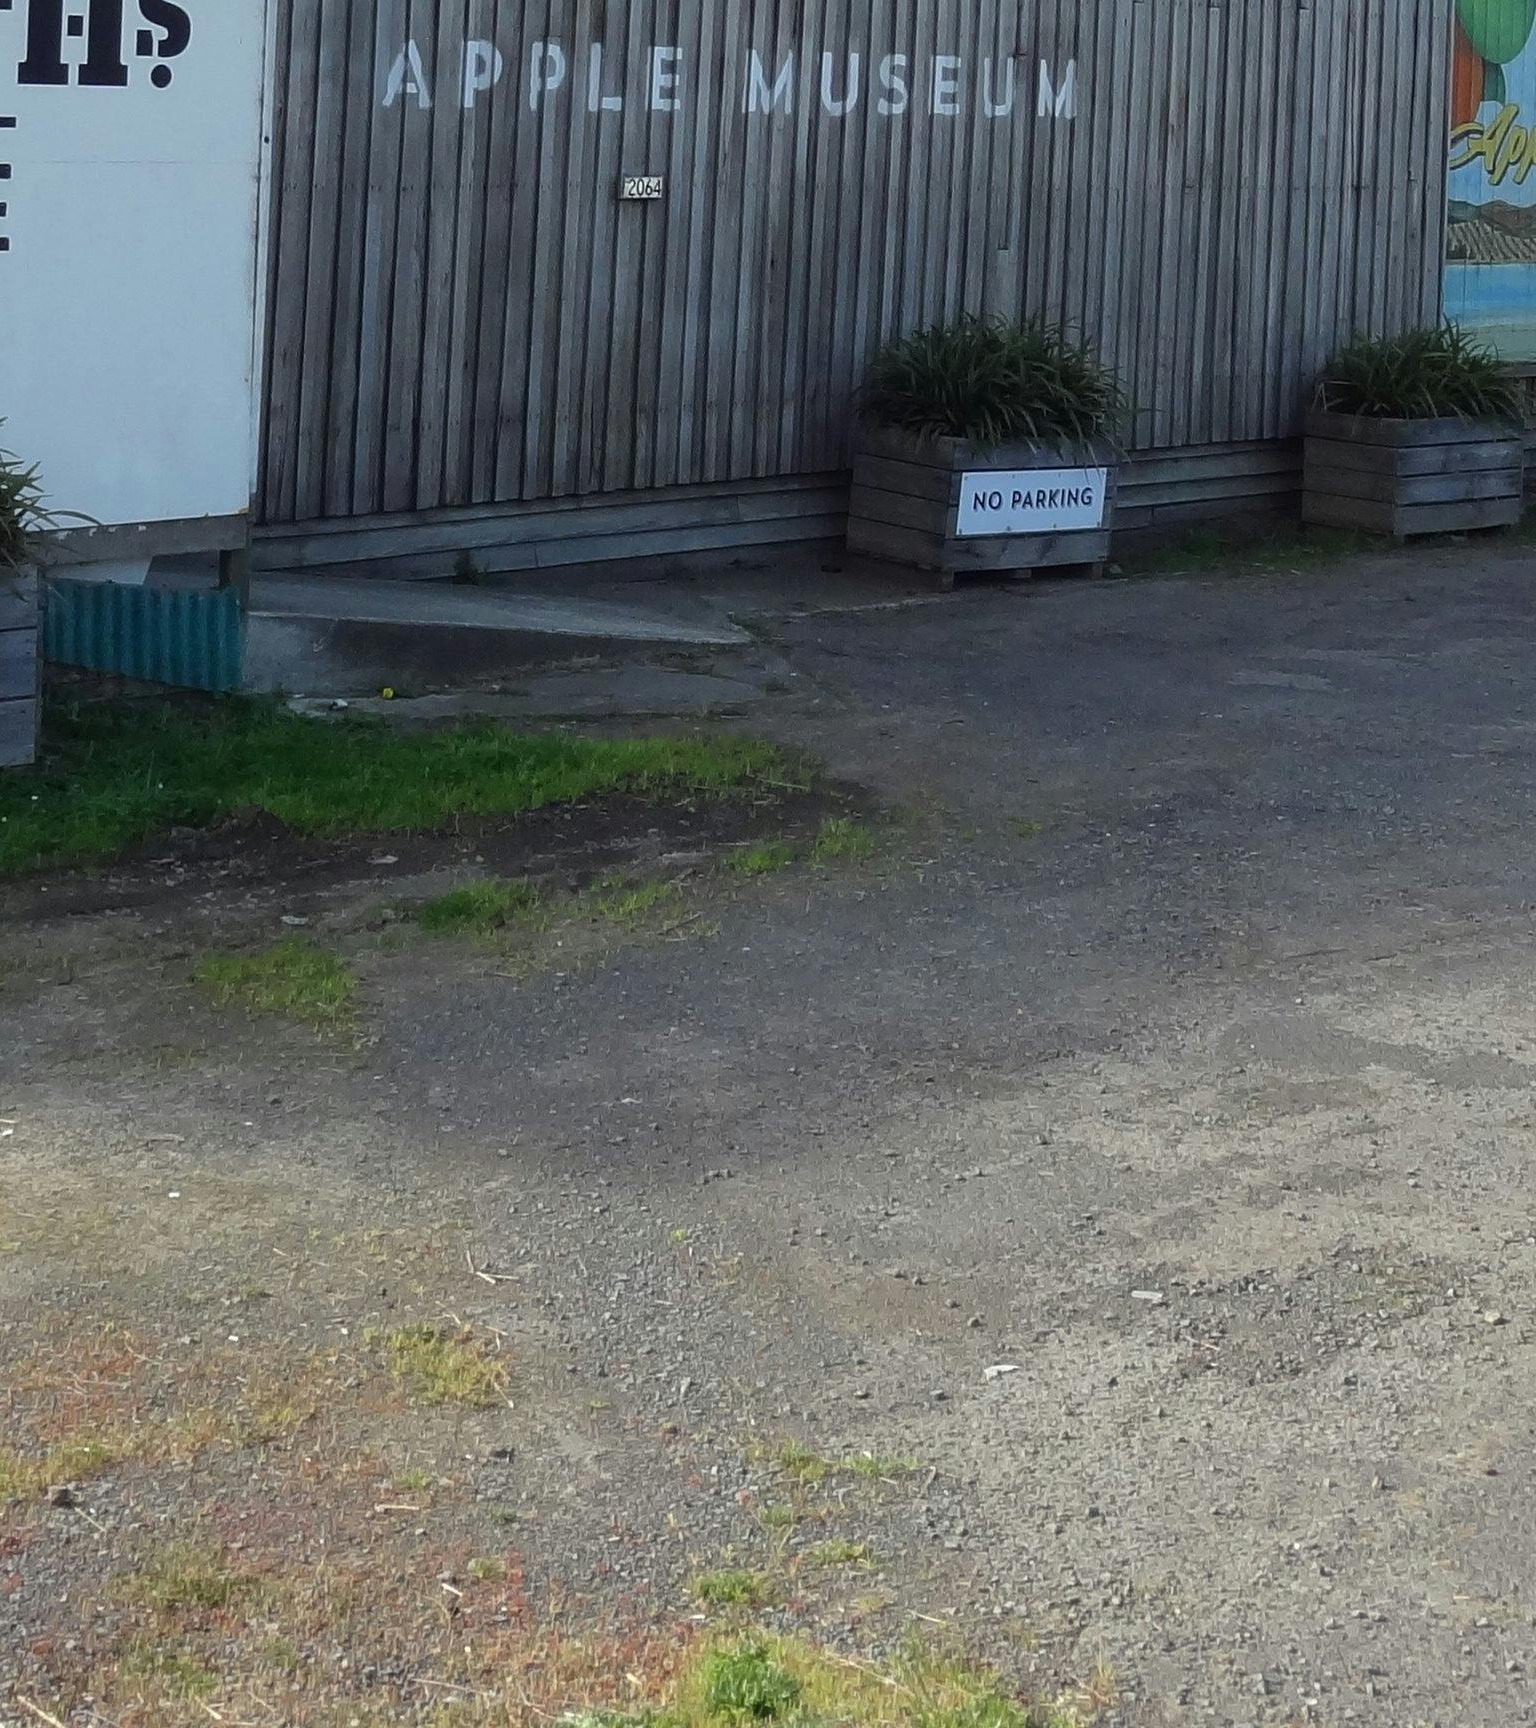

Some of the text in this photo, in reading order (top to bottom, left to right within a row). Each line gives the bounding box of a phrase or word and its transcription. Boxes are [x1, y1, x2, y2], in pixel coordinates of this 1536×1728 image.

[381, 38, 1079, 120] APPLE MUSEUM
[626, 177, 662, 197] 2064
[972, 486, 1094, 513] NO PARKING
